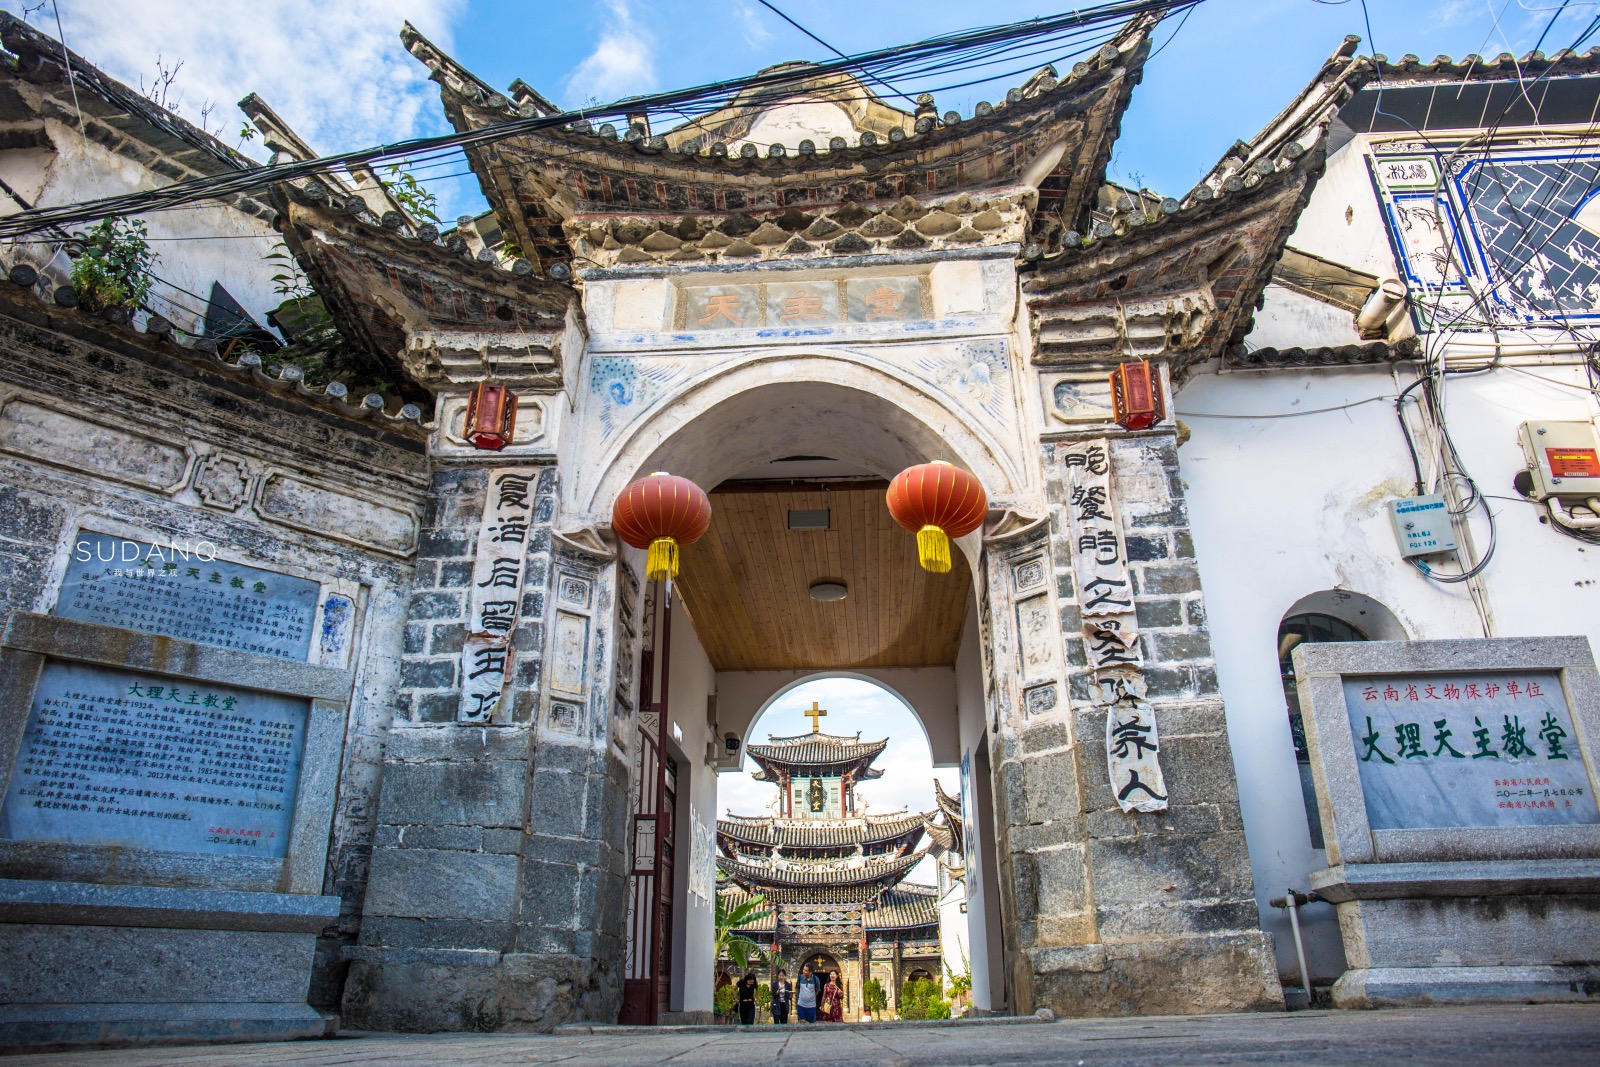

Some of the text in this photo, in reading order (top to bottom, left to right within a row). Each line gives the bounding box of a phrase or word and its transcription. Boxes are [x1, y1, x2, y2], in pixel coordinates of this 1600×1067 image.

[698, 286, 906, 325] 天主堂
[138, 558, 267, 594] 大理天主教堂
[128, 681, 238, 711] 大理天主教堂
[1362, 681, 1545, 702] 云南省文物保护单位
[1361, 712, 1569, 764] 大理天主教堂
[1494, 778, 1551, 787] 云南省人民政府
[1498, 800, 1555, 809] 云南省人民政府
[208, 826, 261, 838] 云南省人民政府
